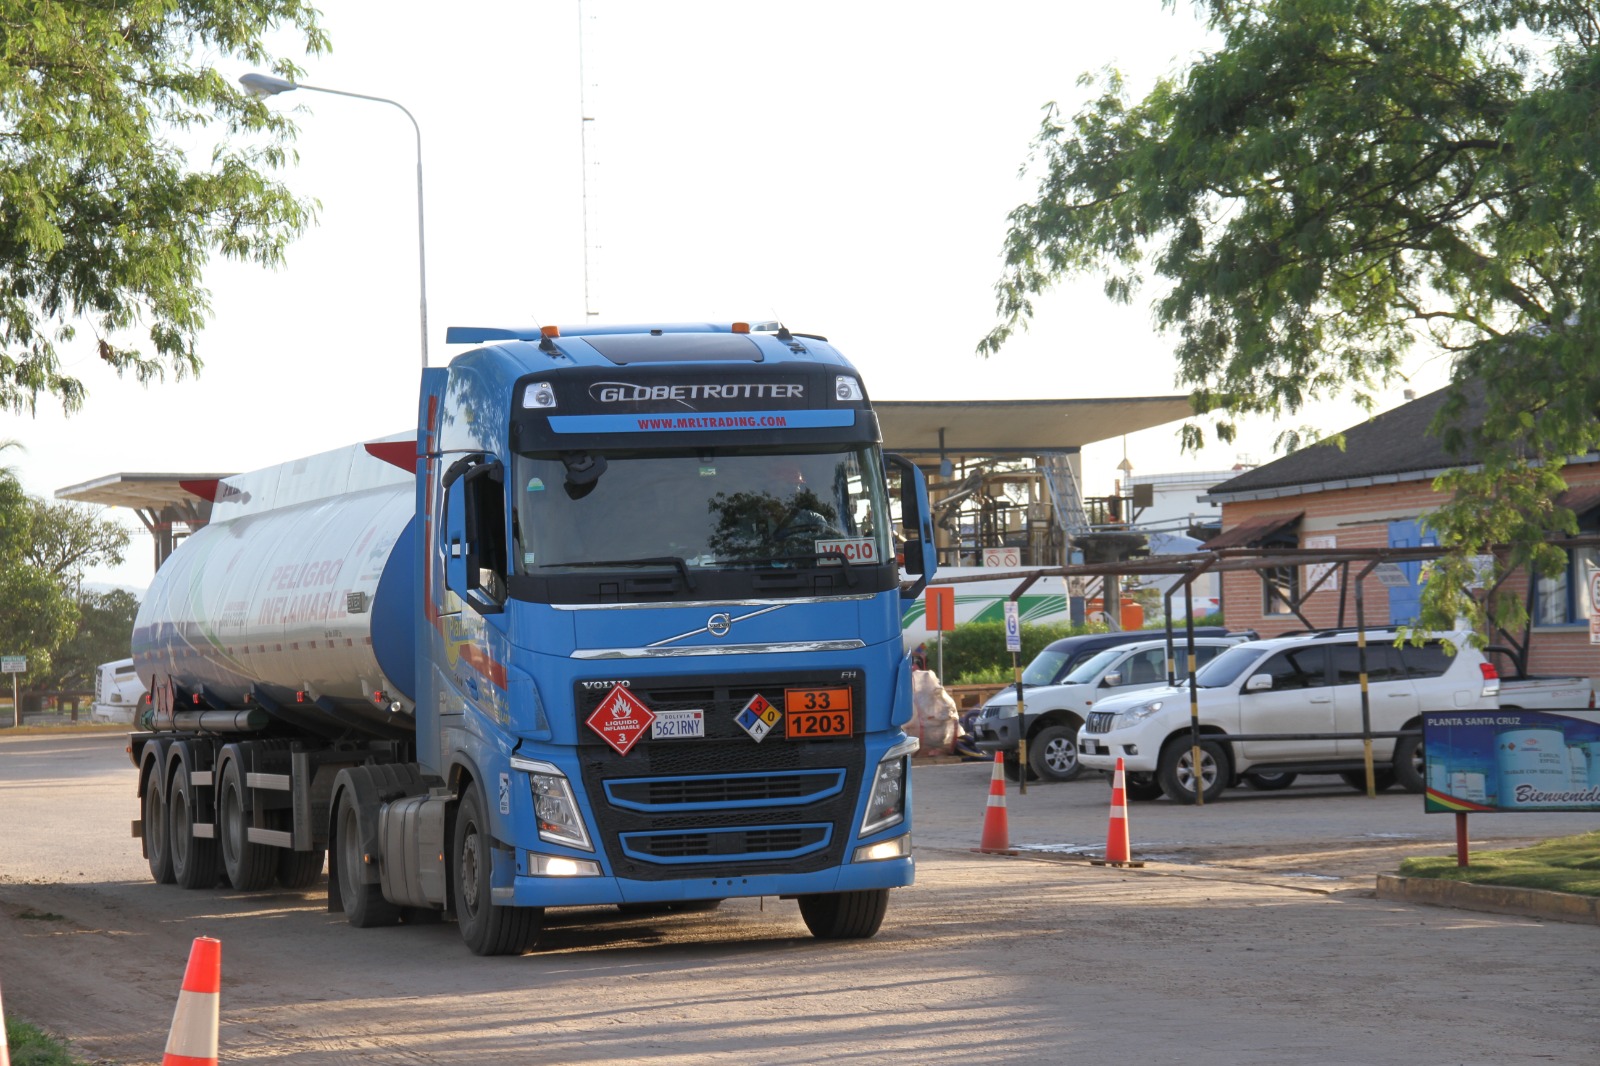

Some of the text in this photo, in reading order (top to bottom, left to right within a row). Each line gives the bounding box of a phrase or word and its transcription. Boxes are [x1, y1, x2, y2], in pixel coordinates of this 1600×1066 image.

[600, 383, 804, 403] GLOBETROTTER
[637, 416, 787, 430] WWW.MRLTRADING.COM
[822, 542, 873, 561] VACIO
[267, 558, 344, 592] PELIGRO
[257, 588, 352, 625] INFLAMABLE
[841, 671, 856, 679] FH
[581, 680, 631, 689] VOLVO
[804, 692, 831, 710] 33
[603, 724, 640, 732] INFLAMABLE
[605, 719, 639, 727] LIQUIDO
[655, 720, 700, 736] 5621RNY
[792, 715, 845, 734] 1203
[1427, 716, 1521, 726] PLANTA SANTA CRUZ
[618, 733, 627, 743] 3
